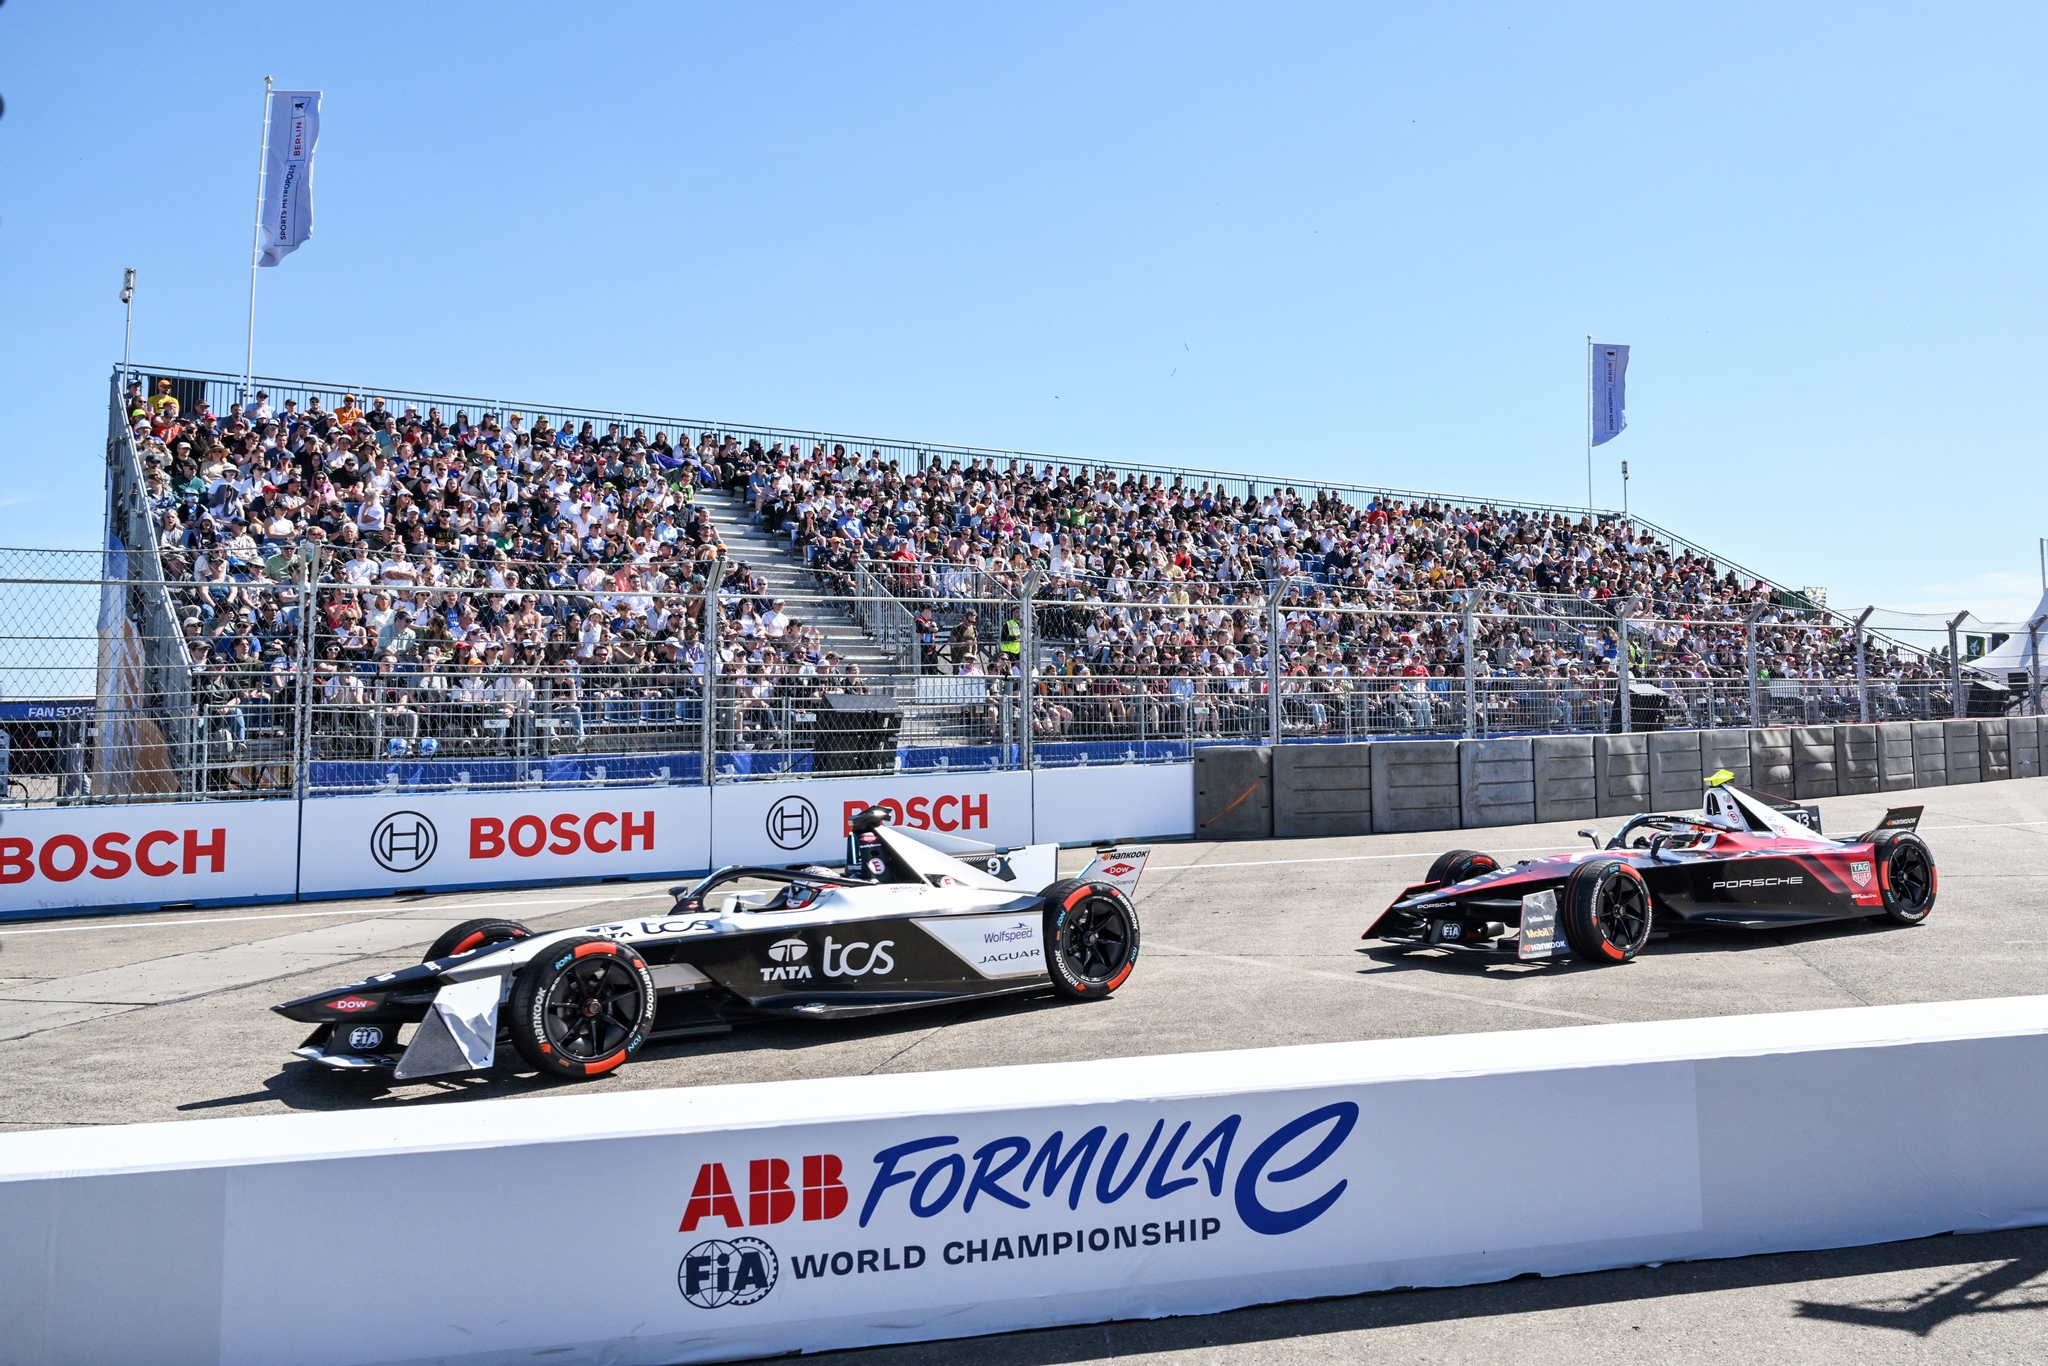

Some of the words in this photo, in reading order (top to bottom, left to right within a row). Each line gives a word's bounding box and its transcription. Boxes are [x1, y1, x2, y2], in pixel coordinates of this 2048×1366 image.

[293, 121, 302, 157] BERLIN
[282, 164, 296, 209] METROPOLIS
[27, 707, 54, 718] FAN
[469, 810, 655, 859] BOSCH
[0, 827, 226, 885] BOSCH
[987, 857, 1001, 876] 9
[1852, 863, 1869, 872] TAG
[1712, 876, 1803, 890] PORSCHE
[1416, 901, 1457, 910] PORSCHE
[640, 919, 714, 935] tcs
[983, 927, 1034, 944] Wolfspeed
[1525, 927, 1549, 939] Mobil
[822, 935, 895, 978] tcs
[977, 948, 1041, 964] JAGUAR
[760, 965, 813, 981] TATA
[678, 1153, 849, 1232] ABB
[858, 1113, 1242, 1229] FORMULA
[790, 1244, 926, 1280] WORLD
[943, 1216, 1221, 1266] CHAMPIONSHIP
